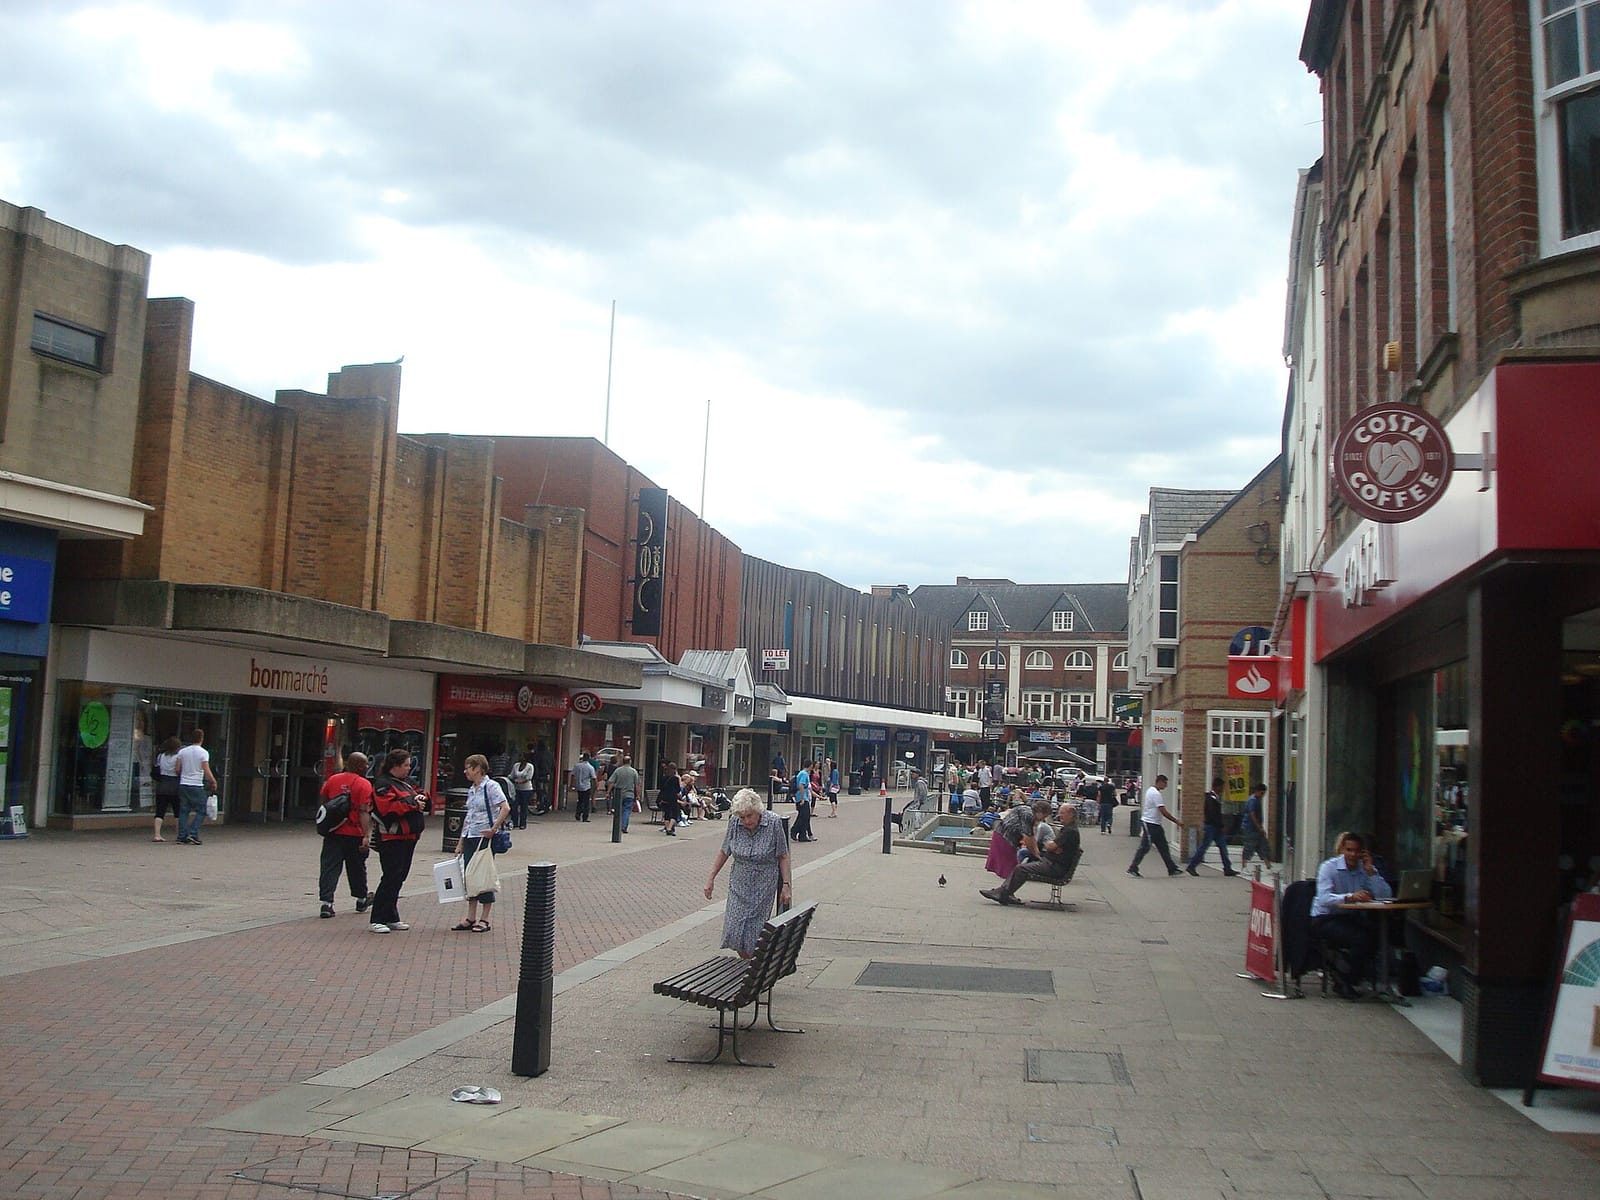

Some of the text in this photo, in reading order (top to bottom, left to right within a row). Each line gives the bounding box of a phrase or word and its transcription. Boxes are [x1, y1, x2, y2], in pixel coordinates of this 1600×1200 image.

[1354, 414, 1429, 443] COSTA
[1350, 471, 1440, 508] COFFEE
[0, 567, 14, 582] e
[250, 658, 328, 694] bonmarché
[1154, 715, 1178, 725] Bright
[1154, 725, 1178, 733] House
